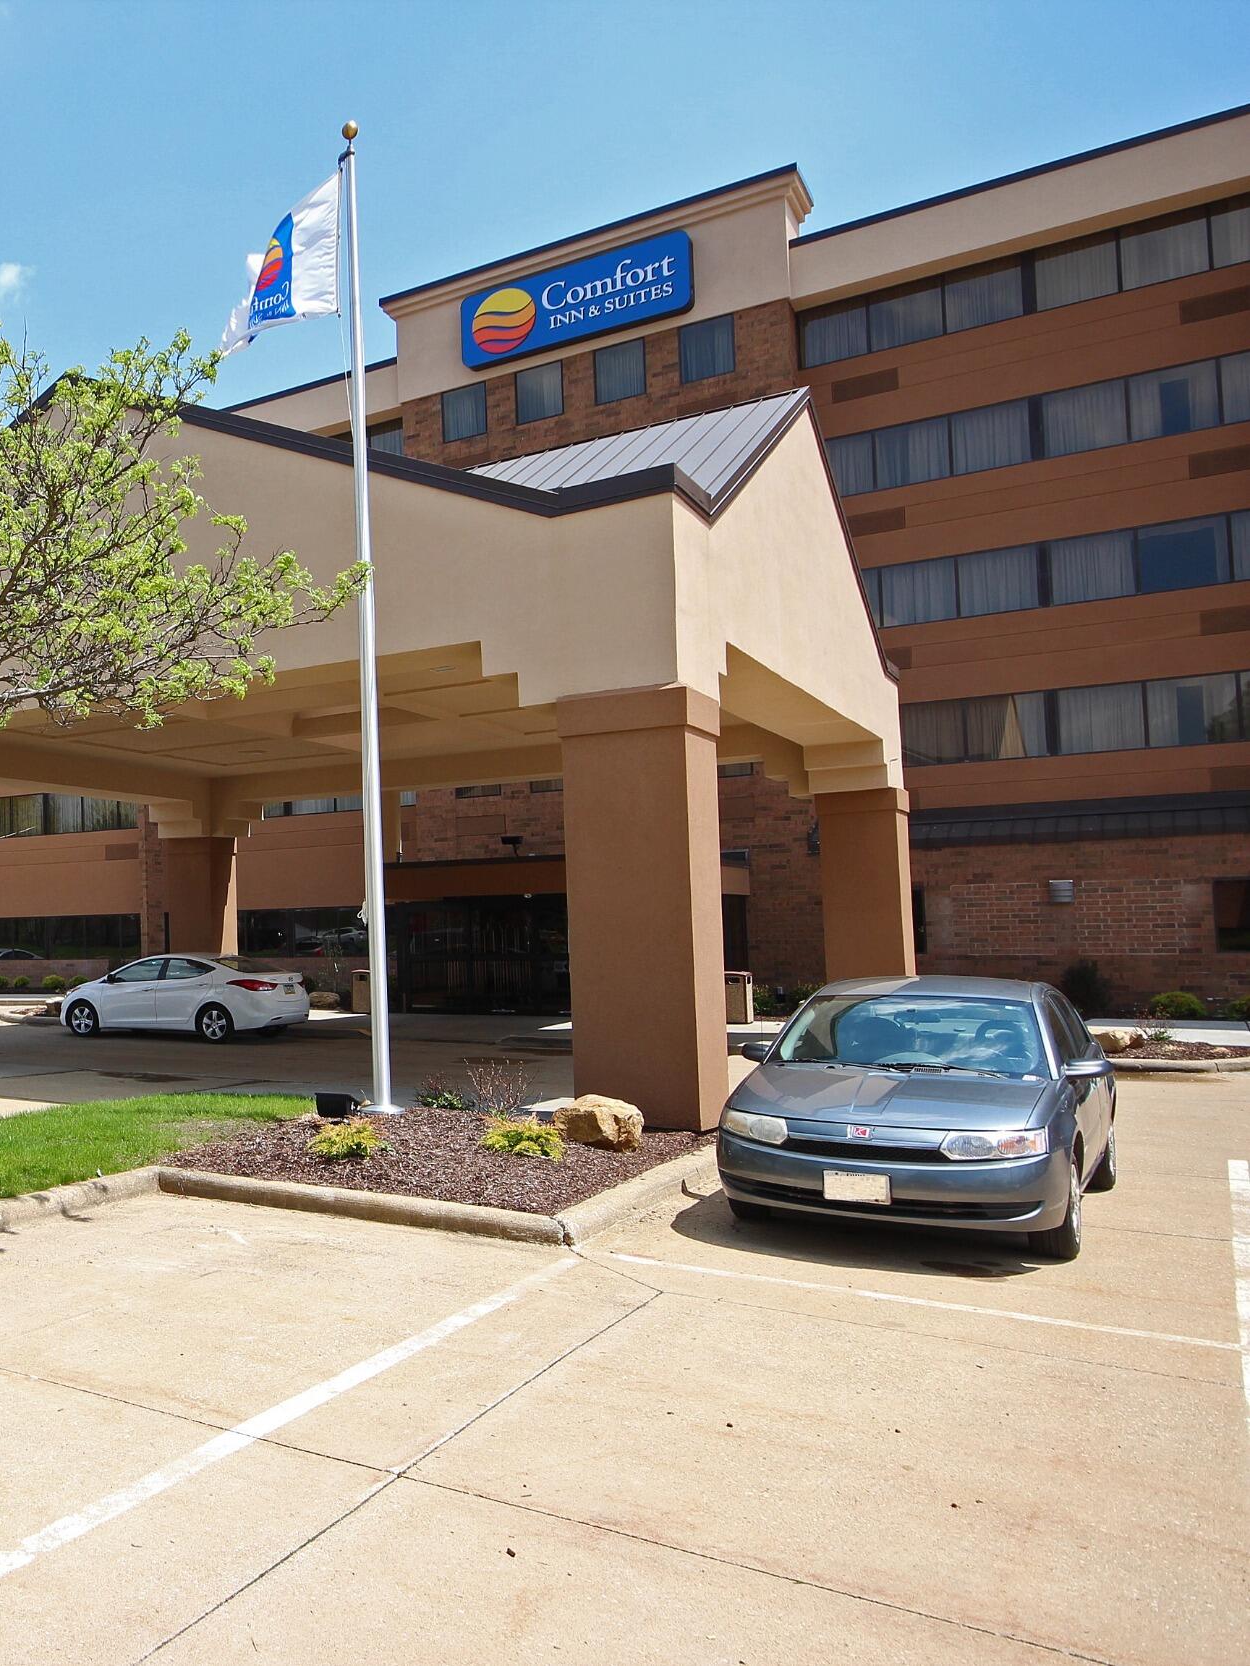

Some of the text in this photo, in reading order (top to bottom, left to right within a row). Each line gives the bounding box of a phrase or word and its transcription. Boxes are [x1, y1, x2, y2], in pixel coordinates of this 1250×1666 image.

[541, 255, 676, 310] Comfort
[550, 282, 673, 329] INN & SUITES
